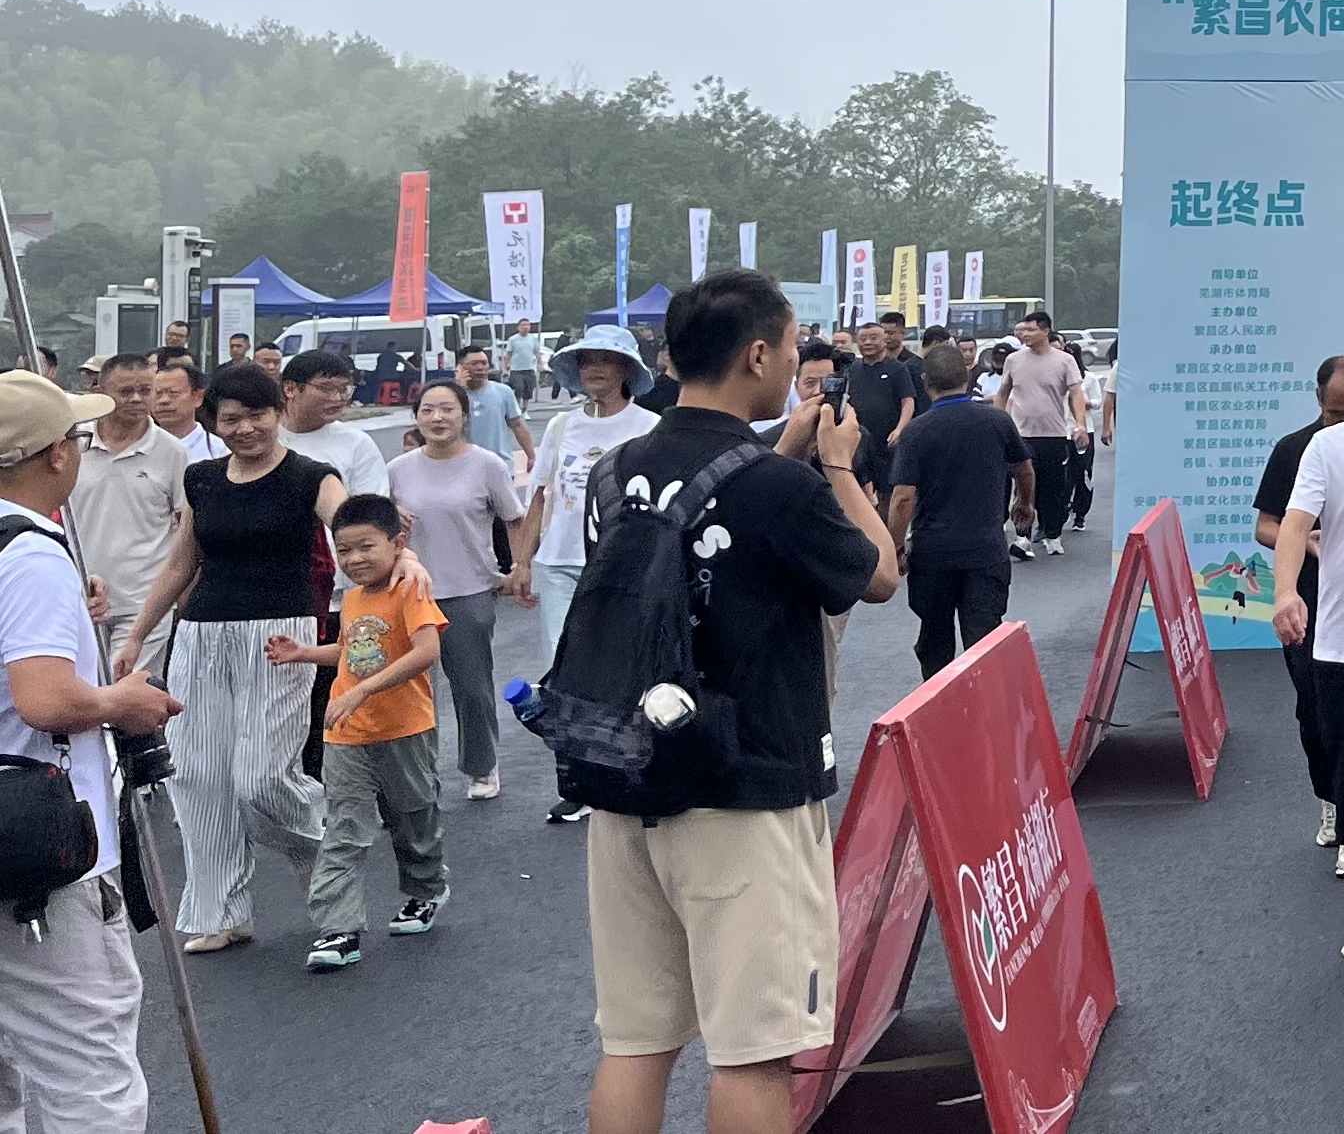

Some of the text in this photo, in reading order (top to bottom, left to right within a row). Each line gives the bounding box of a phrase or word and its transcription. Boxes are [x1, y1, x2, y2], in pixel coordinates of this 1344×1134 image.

[1169, 179, 1306, 228] 起终点
[1211, 268, 1259, 280] 指导单位
[1199, 287, 1270, 299] 芜湖市体育局
[1210, 306, 1258, 317] 主办单位
[1194, 324, 1277, 336] 繁昌区人民政府
[1209, 343, 1257, 355] 承办单位
[1175, 362, 1294, 374] 繁昌区文化旅游体育局
[1184, 400, 1280, 411] 繁昌区农业农村局
[1196, 418, 1267, 430] 繁昌区教育局
[1183, 456, 1266, 468] 各镇、繁昌经开
[1206, 475, 1254, 487] 协办单位
[1205, 514, 1253, 525] 冠名单位
[1193, 532, 1253, 544] 繁昌农商银
